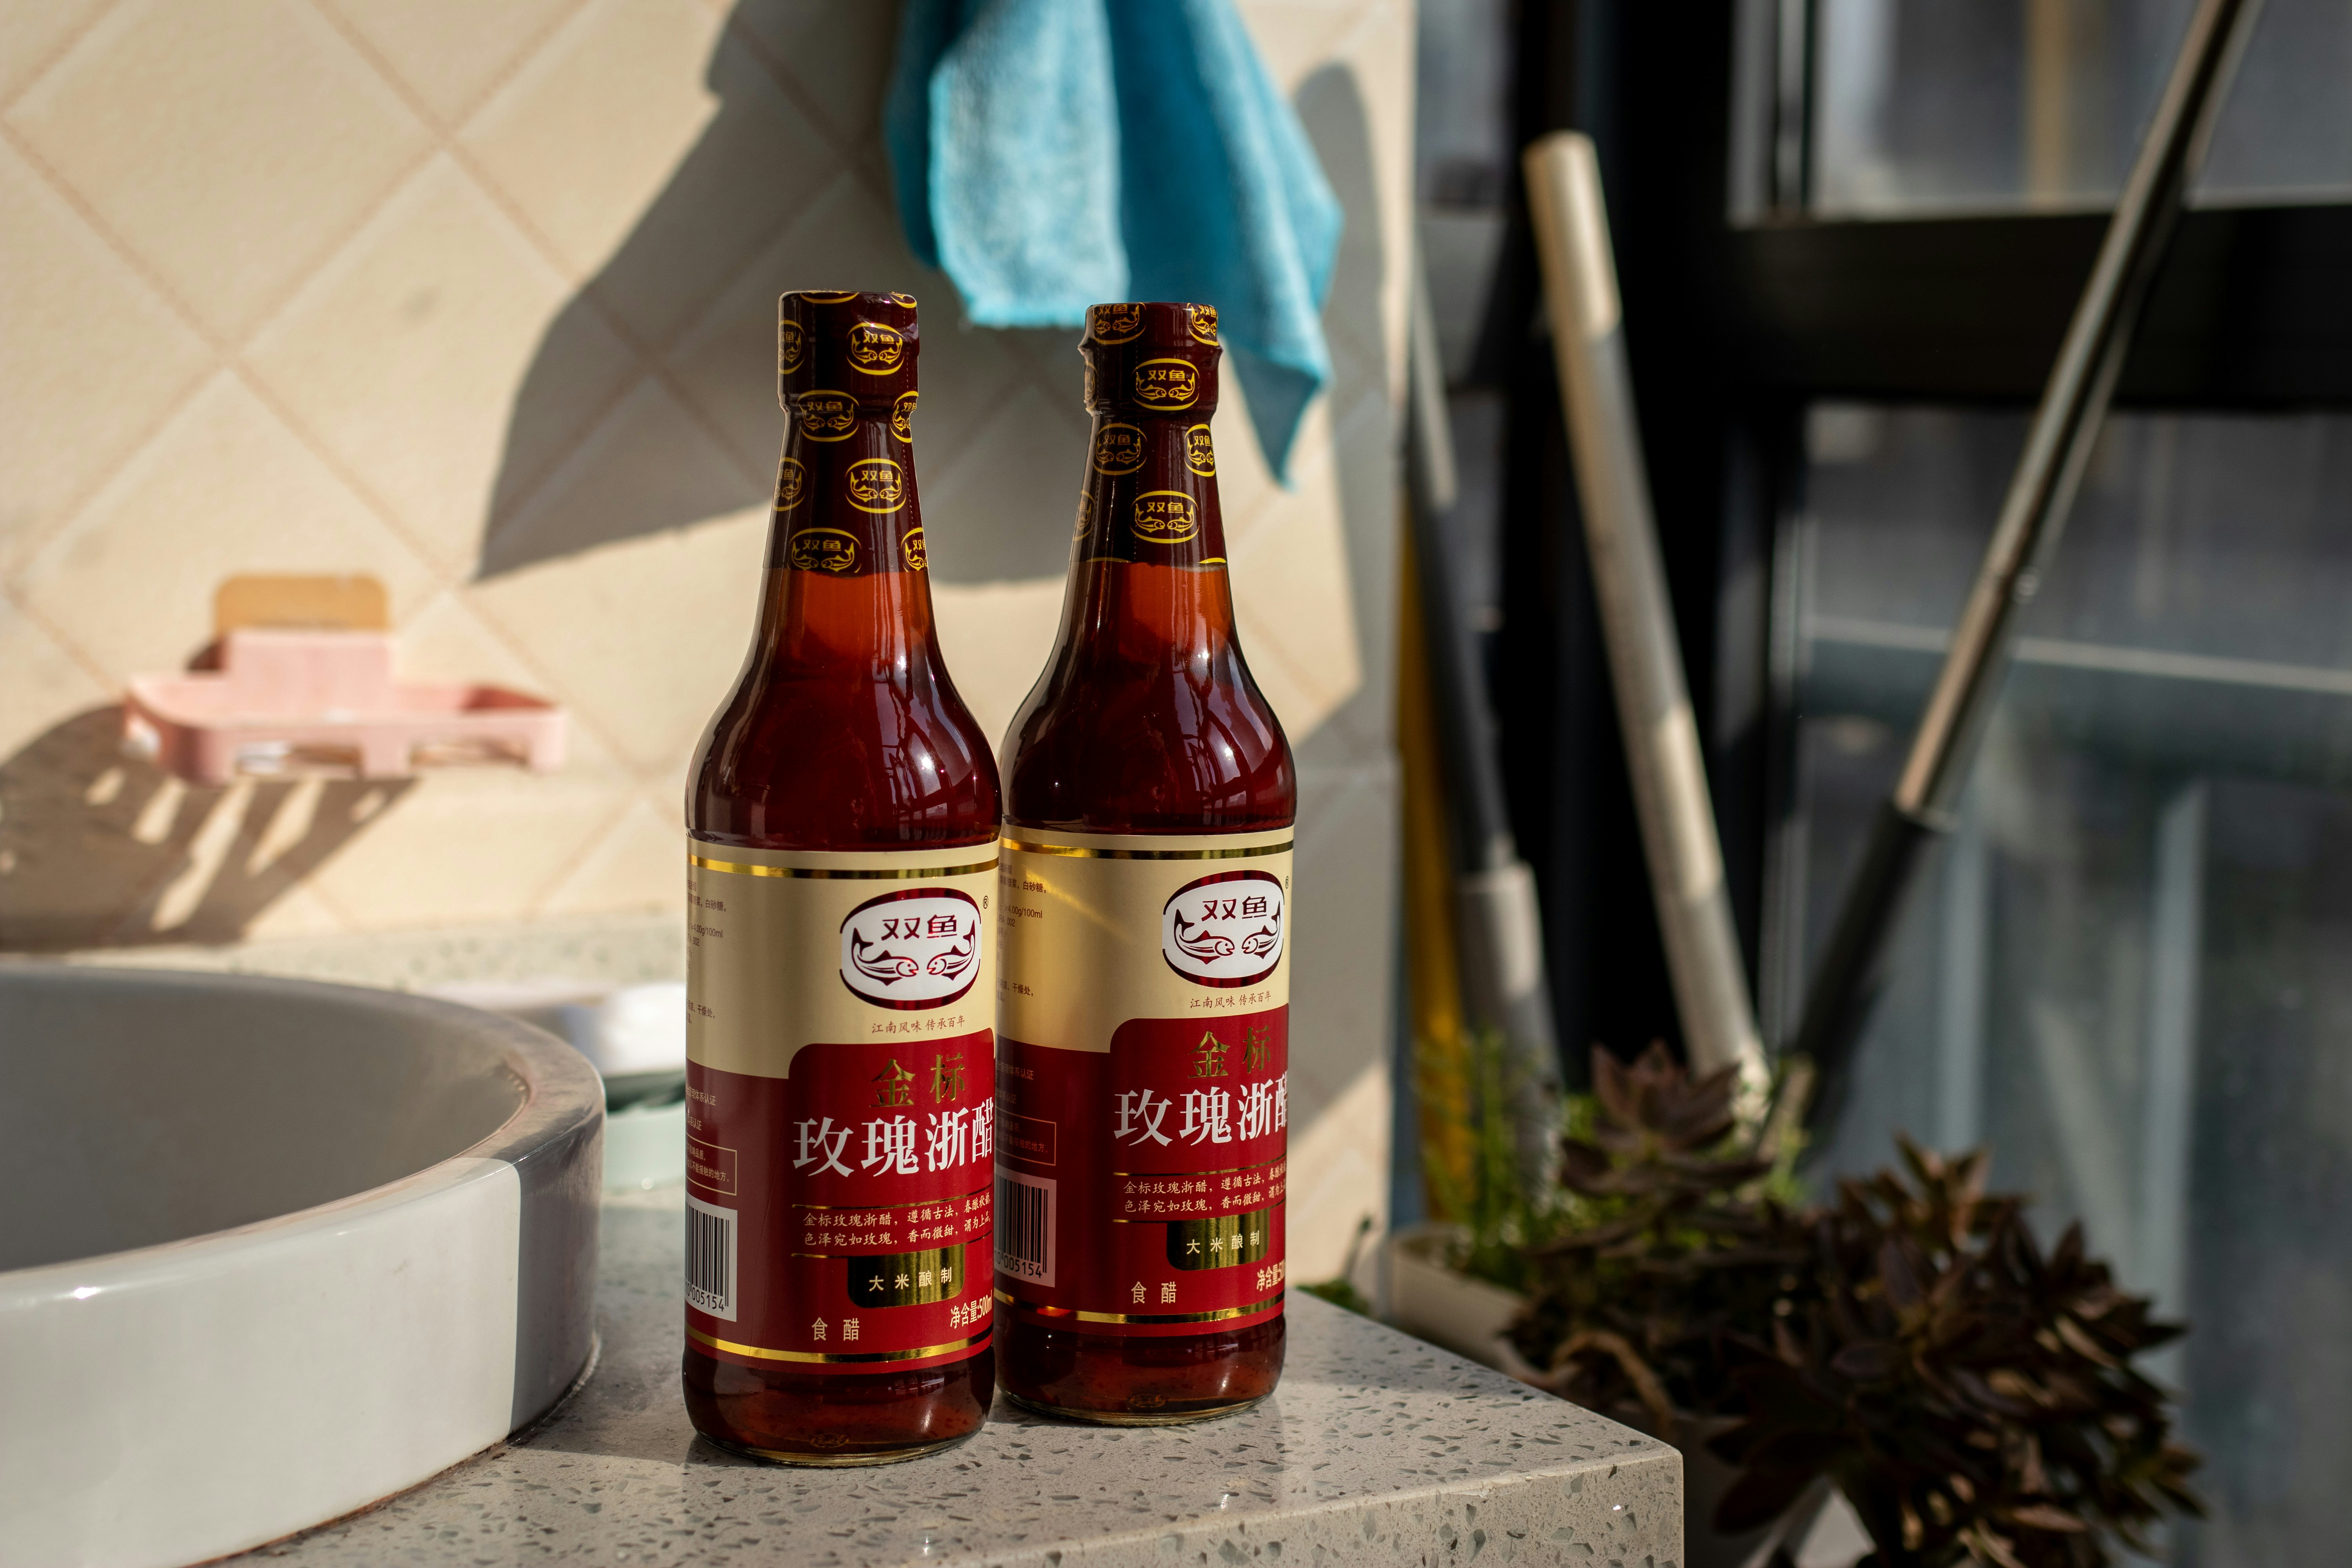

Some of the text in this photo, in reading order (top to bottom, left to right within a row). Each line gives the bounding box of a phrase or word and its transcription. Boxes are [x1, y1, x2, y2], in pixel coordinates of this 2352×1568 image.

[863, 332, 894, 344] 双鱼
[1148, 370, 1186, 381] 双鱼
[807, 401, 843, 412] 双鱼
[1104, 434, 1131, 446] 双鱼
[1194, 435, 1210, 446] 双鱼
[861, 470, 893, 481] 双鱼
[1147, 501, 1184, 513] 双鱼
[803, 539, 842, 551] 双鱼
[1201, 895, 1267, 922] 双鱼
[880, 914, 958, 940] 双鱼
[1007, 918, 1015, 927] 002
[1190, 990, 1271, 1009] 江南风味 传承百年
[872, 1014, 965, 1034] 江南风味 传承百年
[1188, 1025, 1271, 1079] 金标
[869, 1053, 965, 1108] 金标
[793, 1097, 994, 1177] 玫瑰浙醋
[1186, 1232, 1260, 1255] 大米酿制
[1004, 1255, 1042, 1278] 005154
[869, 1267, 952, 1292] 大米酿制
[692, 1287, 724, 1312] 005154
[1131, 1281, 1177, 1305] 食醋
[812, 1317, 859, 1341] 食醋
